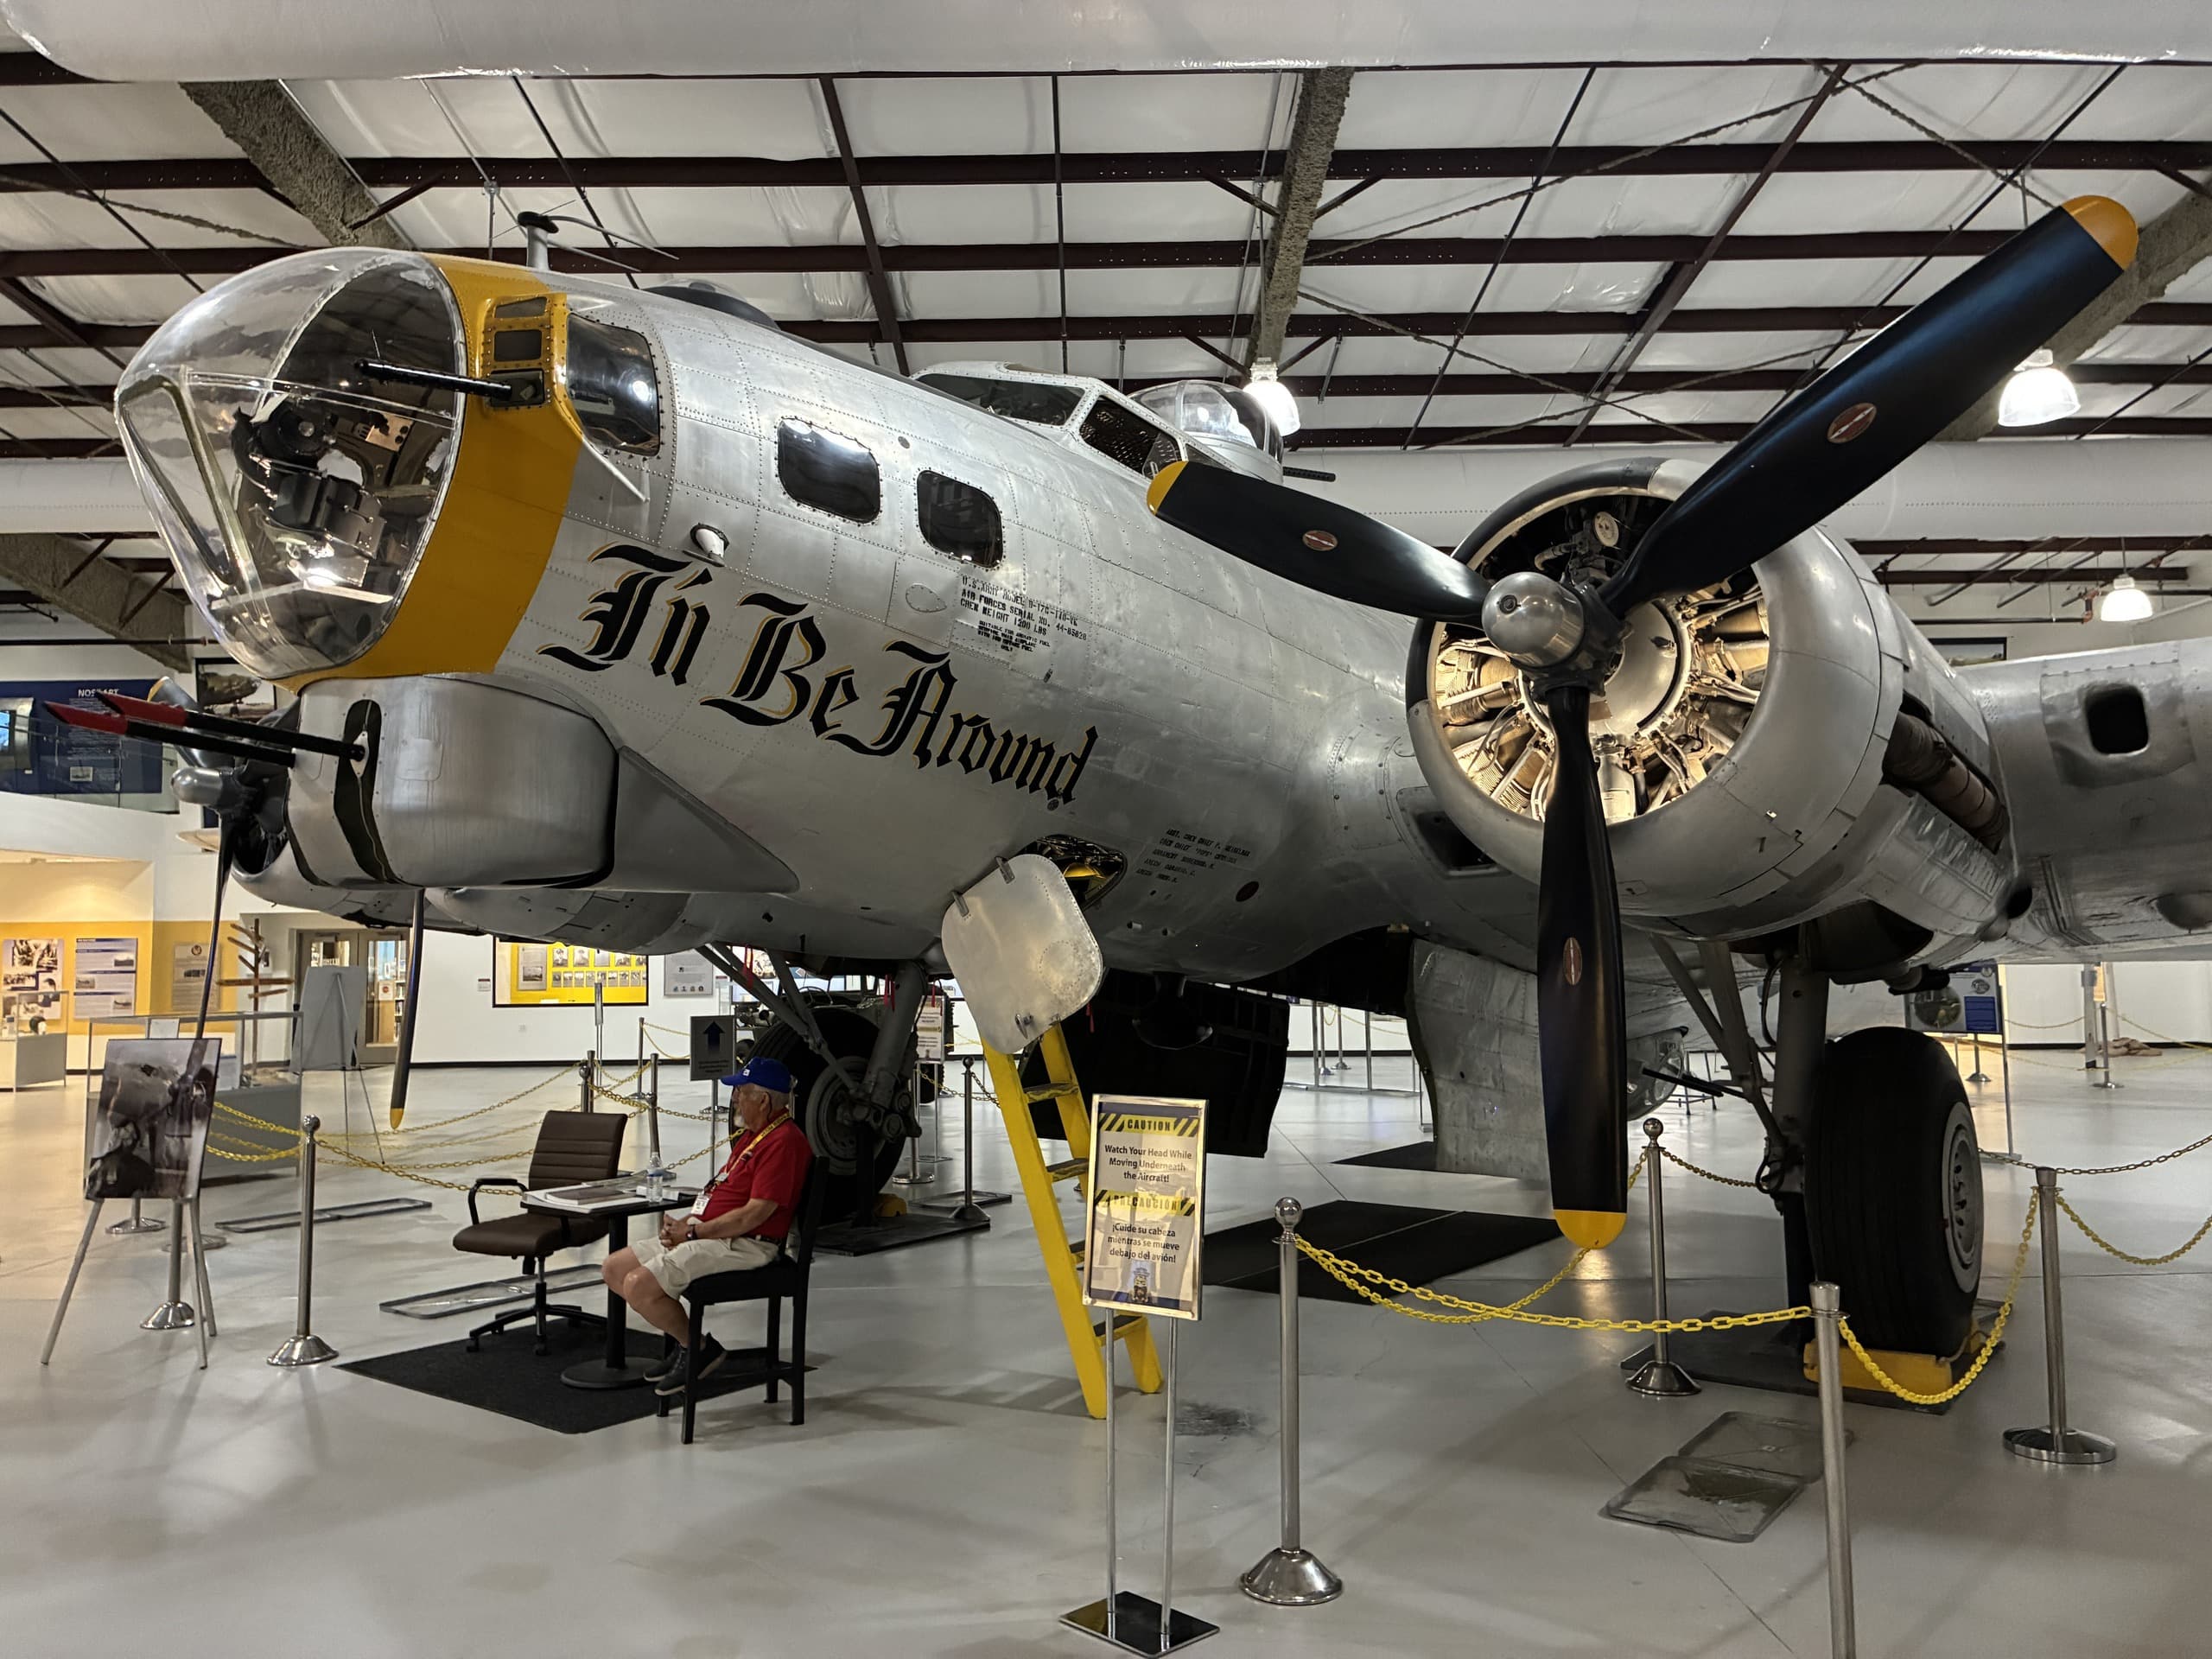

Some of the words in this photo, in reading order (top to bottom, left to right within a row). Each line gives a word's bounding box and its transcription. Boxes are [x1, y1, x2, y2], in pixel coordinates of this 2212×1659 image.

[962, 589, 976, 601] AIR
[980, 595, 1006, 611] FORCES
[1010, 607, 1035, 621] SERIAL
[1039, 616, 1051, 626] NO.
[961, 599, 978, 612] CREW
[982, 607, 1009, 622] WEIGHT
[1014, 618, 1031, 629] 1200
[1034, 624, 1046, 635] LBS
[979, 620, 1002, 632] SUITABLE
[699, 592, 861, 738] Be
[824, 640, 1100, 804] Around
[1127, 1119, 1171, 1131] CAUTION
[1105, 1145, 1128, 1155] Watch
[1129, 1146, 1146, 1155] Your
[1147, 1147, 1168, 1157] Head
[1170, 1149, 1192, 1159] While
[1109, 1157, 1138, 1169] Moving
[1139, 1160, 1185, 1172] Underneath
[1124, 1172, 1136, 1180] the
[1137, 1173, 1169, 1183] Aircraft!
[1112, 1224, 1136, 1233] ¡Cuide
[1148, 1227, 1175, 1237] cabeza
[1108, 1236, 1141, 1247] mientras
[1154, 1241, 1179, 1250] mueve
[1109, 1249, 1136, 1259] debajo
[1138, 1250, 1149, 1260] del
[1152, 1253, 1176, 1262] avión!
